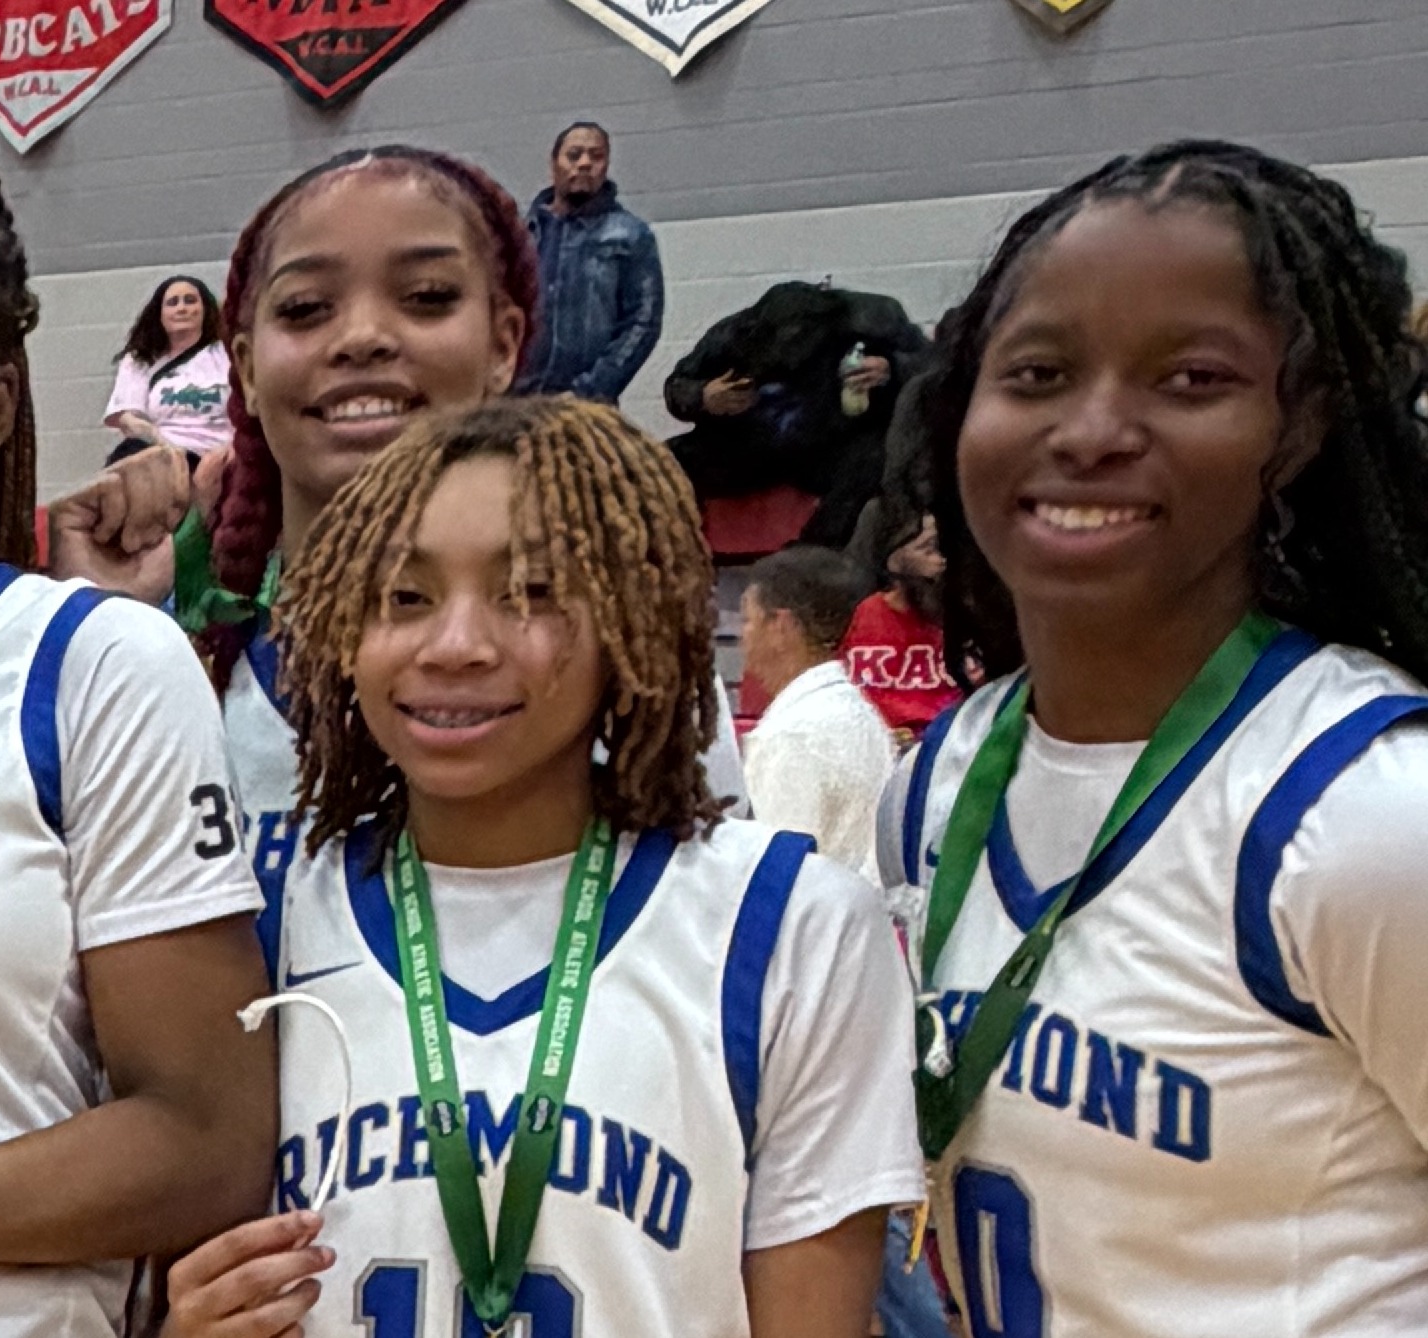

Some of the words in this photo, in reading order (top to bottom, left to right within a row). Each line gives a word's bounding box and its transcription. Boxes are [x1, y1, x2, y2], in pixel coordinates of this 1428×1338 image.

[847, 644, 958, 692] KA
[189, 783, 236, 860] 3
[419, 1004, 444, 1082] ASSOCIATION
[542, 994, 574, 1077] ASSOCIATION
